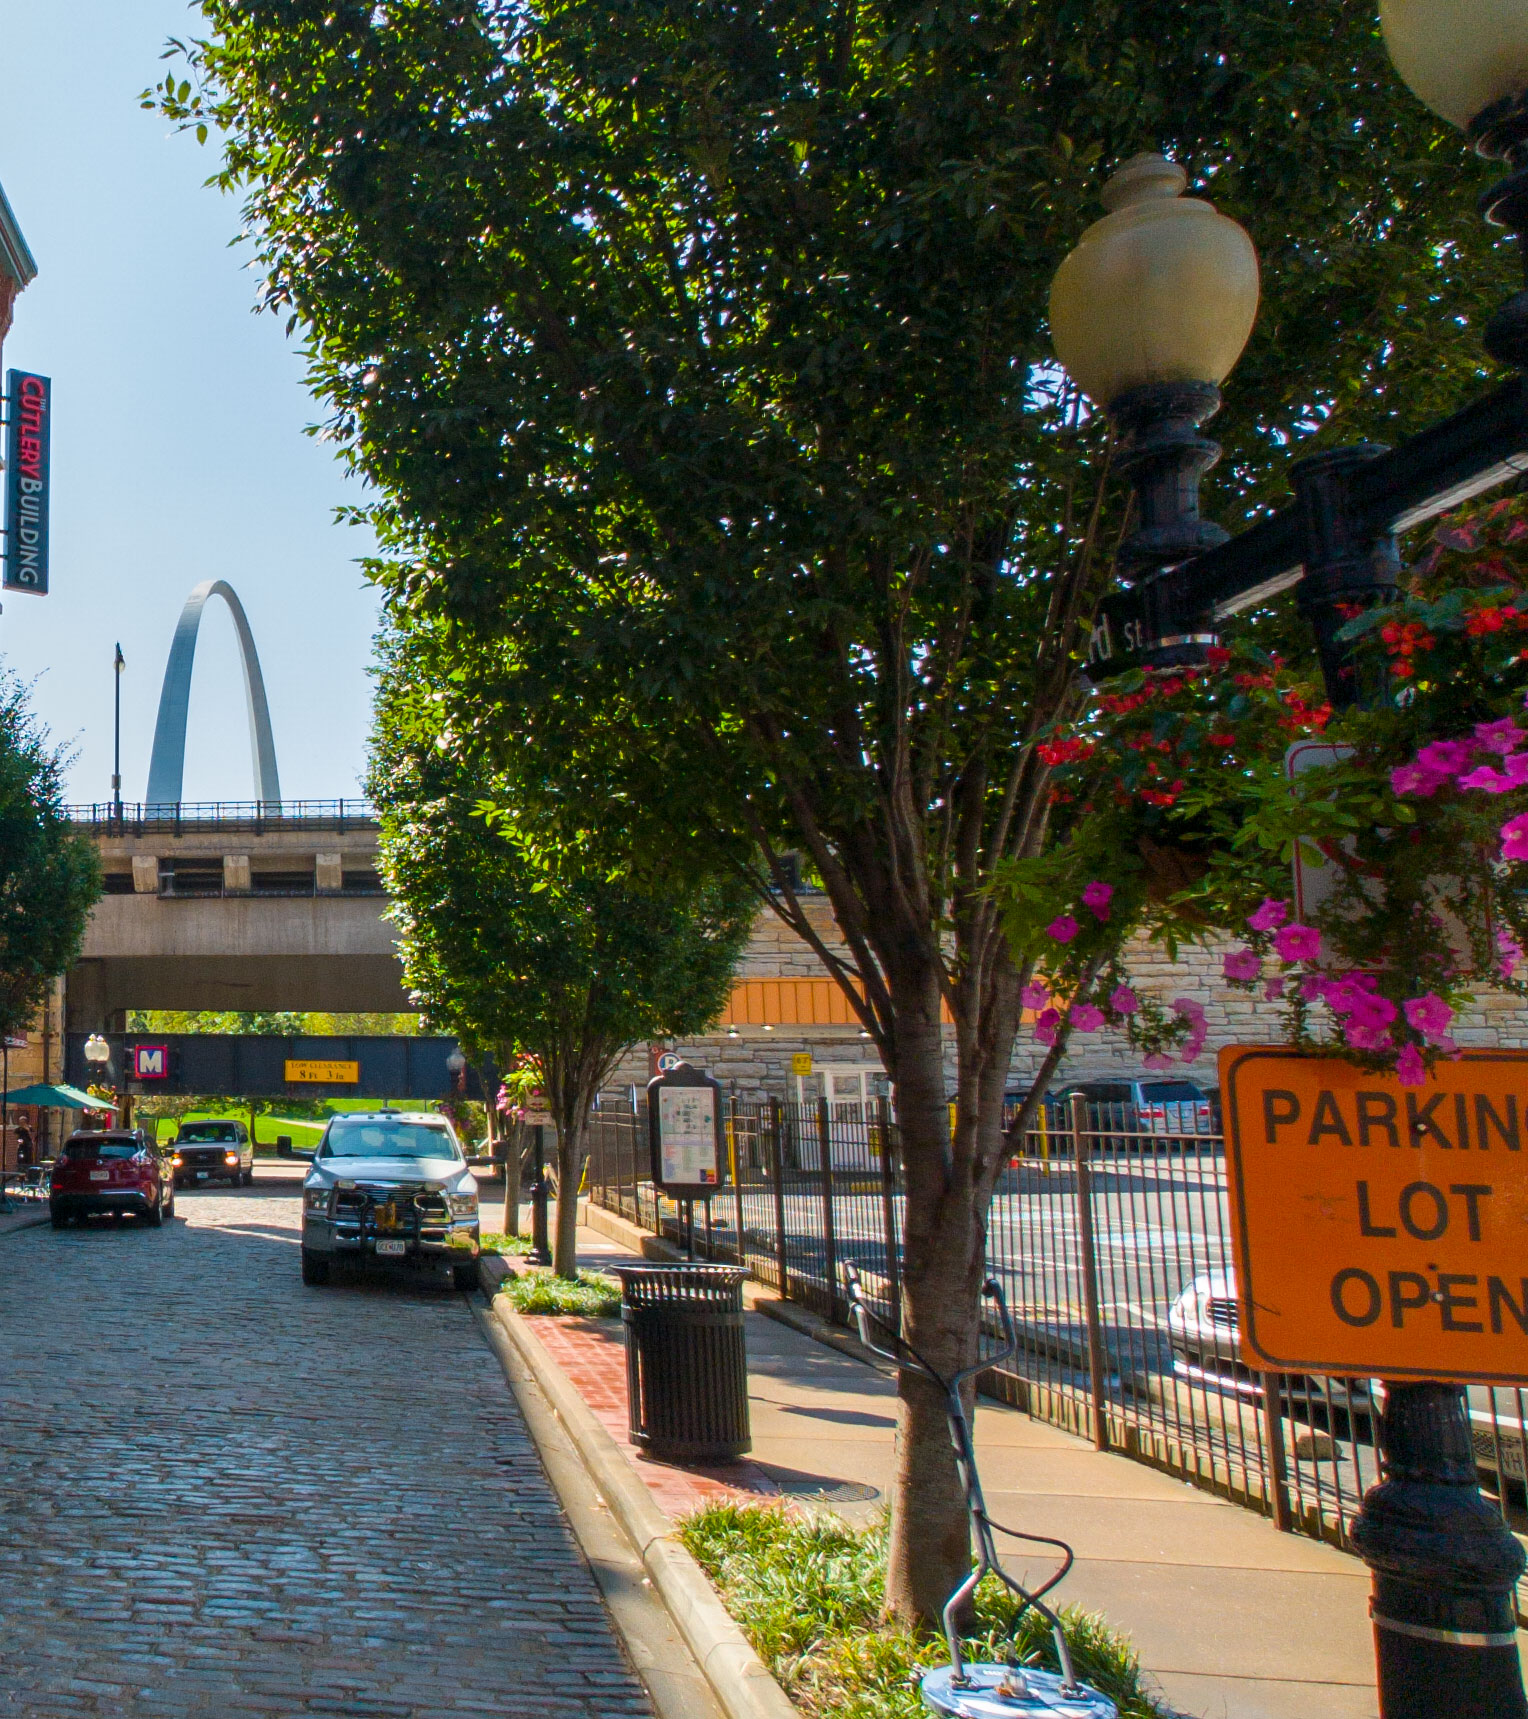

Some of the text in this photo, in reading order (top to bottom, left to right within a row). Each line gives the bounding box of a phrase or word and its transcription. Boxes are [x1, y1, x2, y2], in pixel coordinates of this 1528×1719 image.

[19, 376, 45, 584] CUTLERY BUILDING
[139, 1050, 163, 1073] M
[299, 1069, 306, 1079] 8
[325, 1070, 333, 1079] 3
[309, 1062, 352, 1070] CLEARANCE
[1262, 1089, 1528, 1151] PARKIN
[1357, 1180, 1493, 1242] LOT
[1330, 1267, 1528, 1335] OPEN
